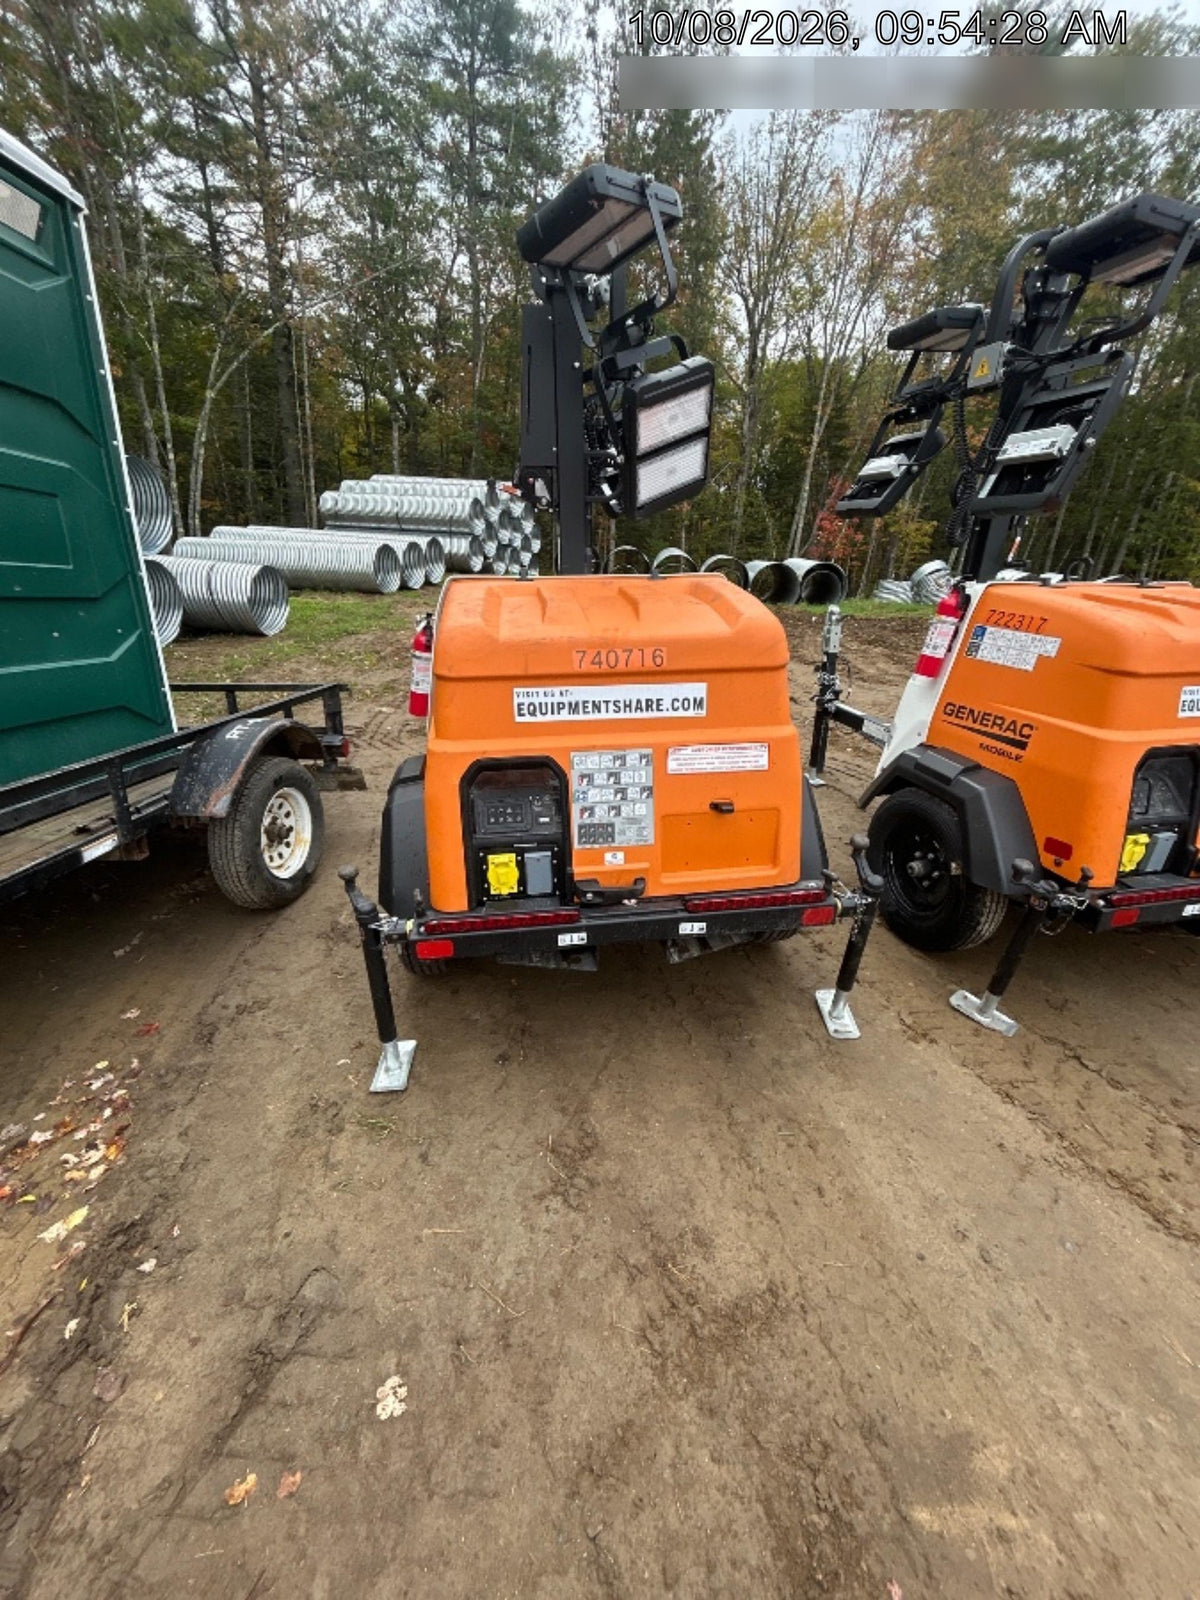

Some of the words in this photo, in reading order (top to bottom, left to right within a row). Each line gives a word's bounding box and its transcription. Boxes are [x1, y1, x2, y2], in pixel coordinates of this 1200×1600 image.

[985, 609, 1048, 634] 722317
[575, 648, 665, 669] 740716
[516, 696, 705, 717] EQUIPMENTSHARE.COM
[943, 701, 1034, 740] GENERAC
